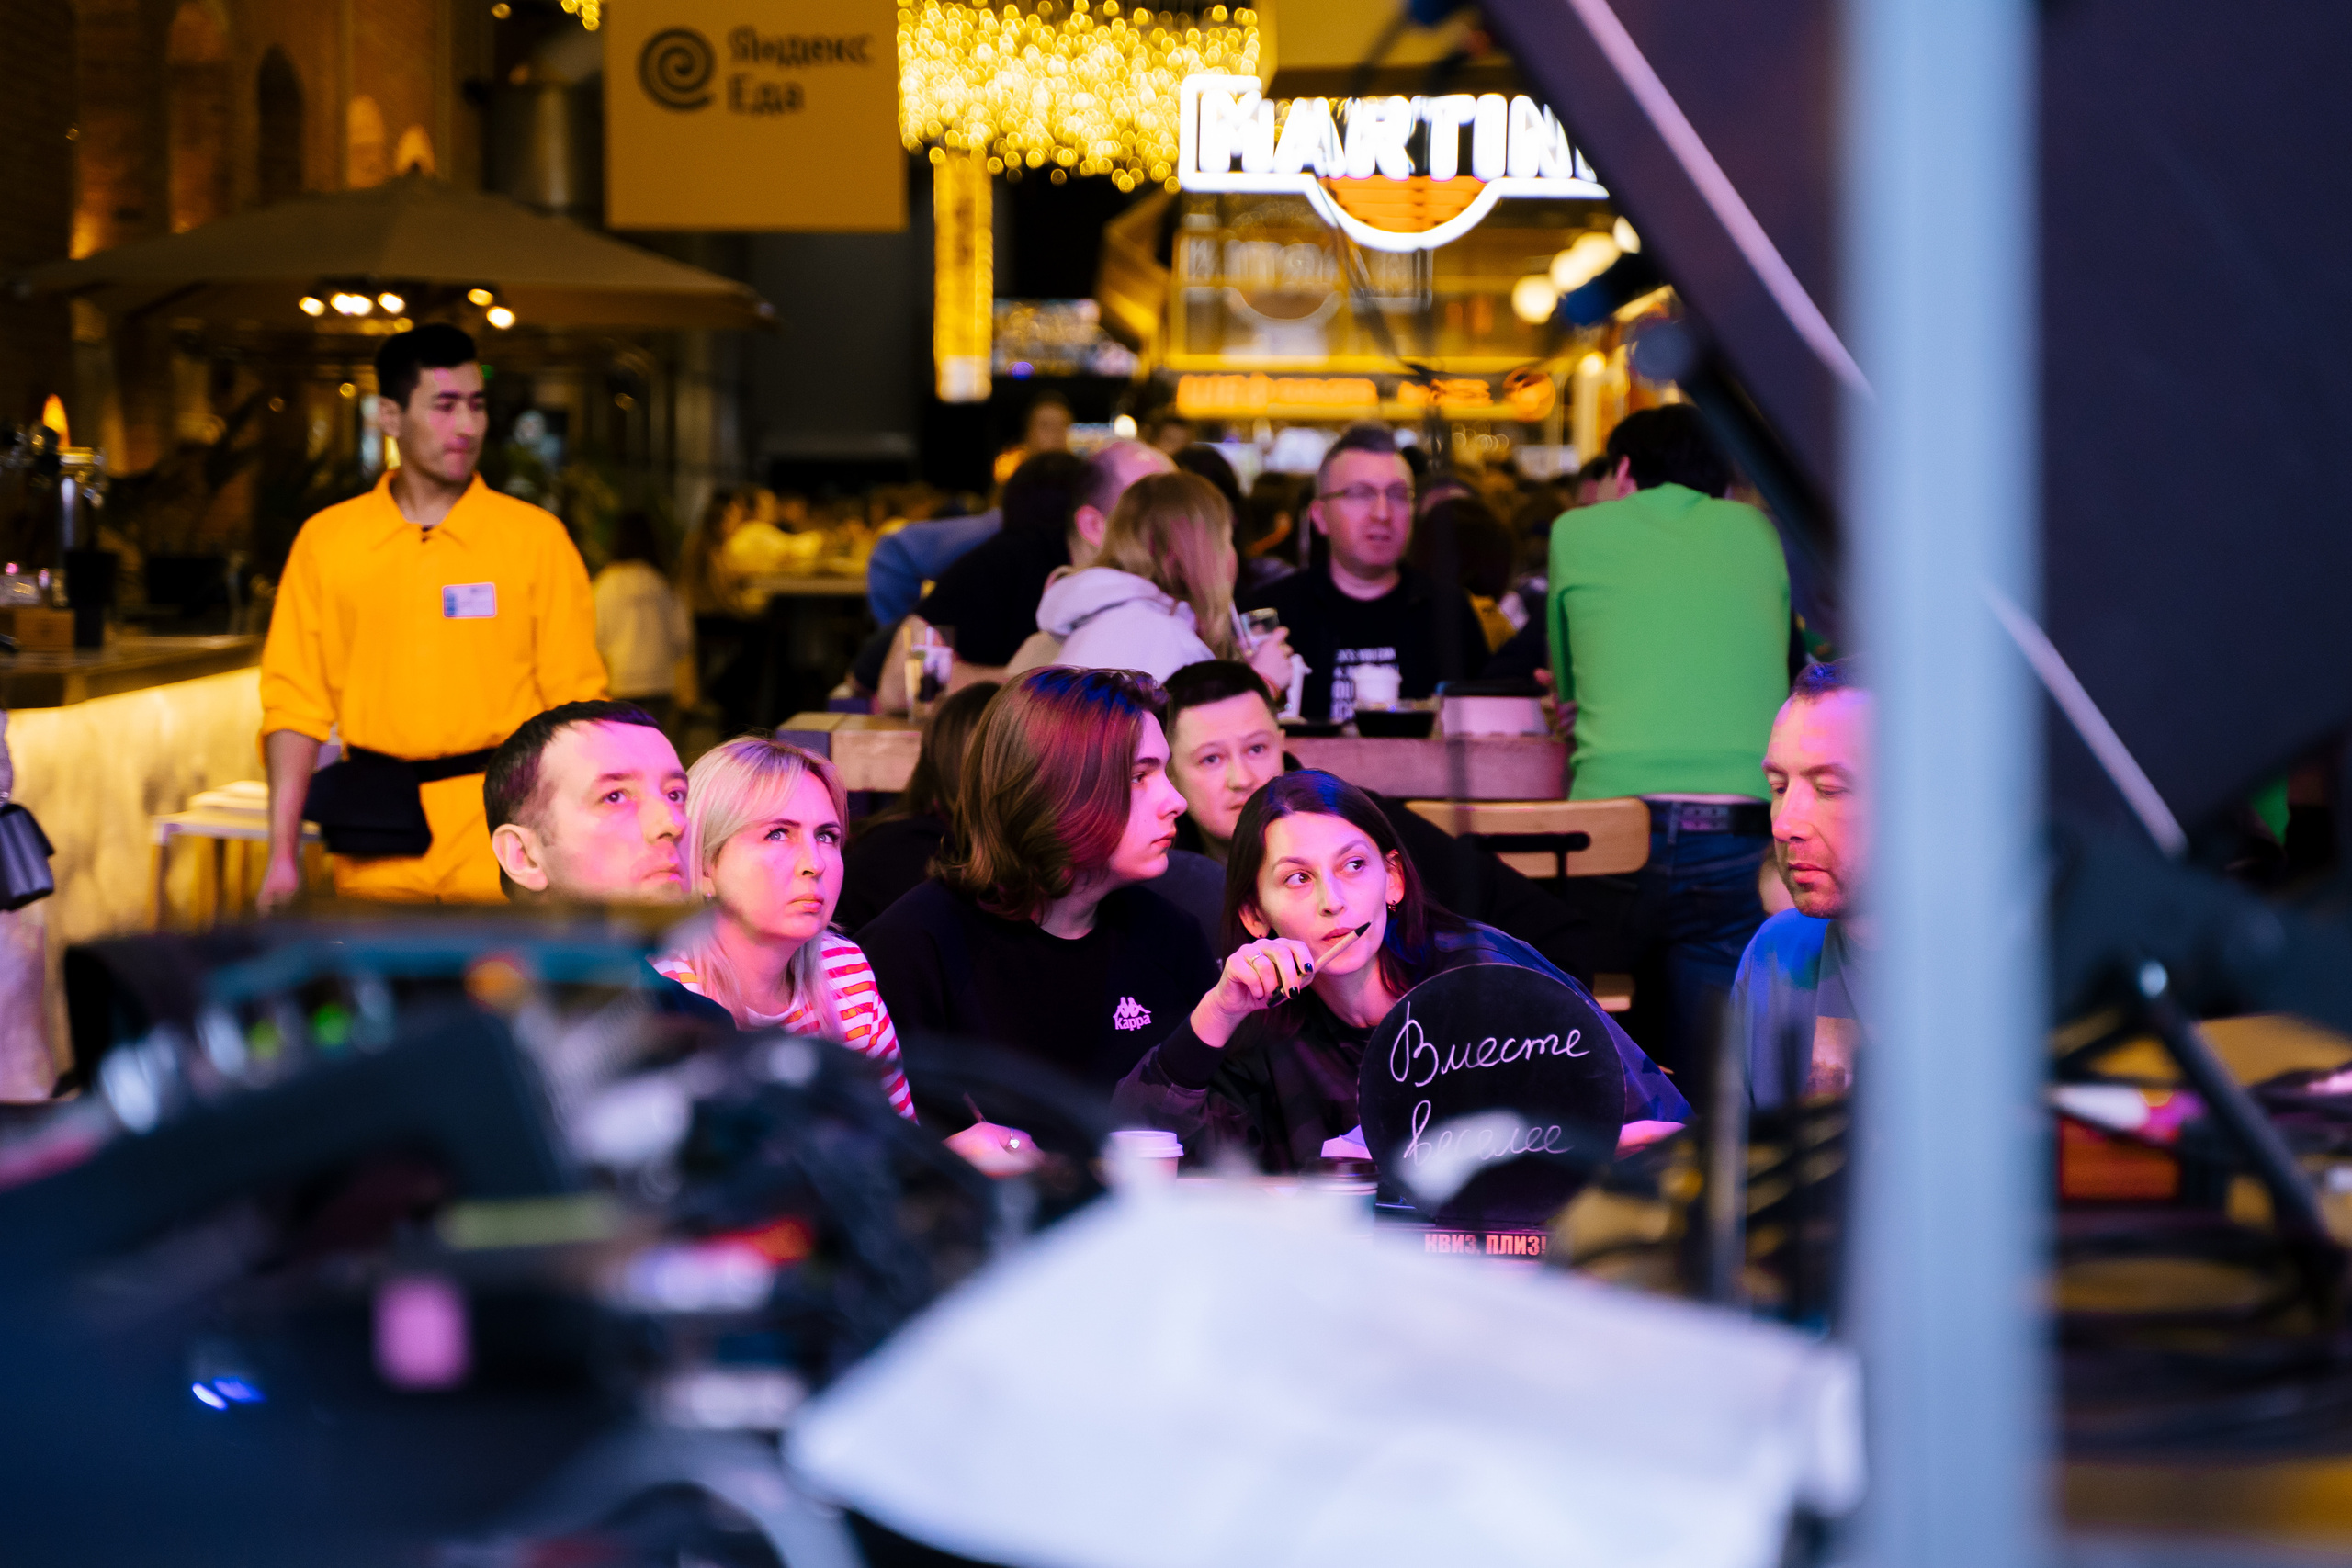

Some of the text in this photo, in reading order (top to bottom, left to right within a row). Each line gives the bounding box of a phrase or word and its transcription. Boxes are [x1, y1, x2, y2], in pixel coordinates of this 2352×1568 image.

[729, 25, 876, 67] Яндекс
[728, 73, 806, 116] Еда
[1198, 92, 1597, 182] MARTIN
[1390, 1001, 1590, 1088] Вместе
[1486, 1235, 1547, 1256] ПЛИЗ!
